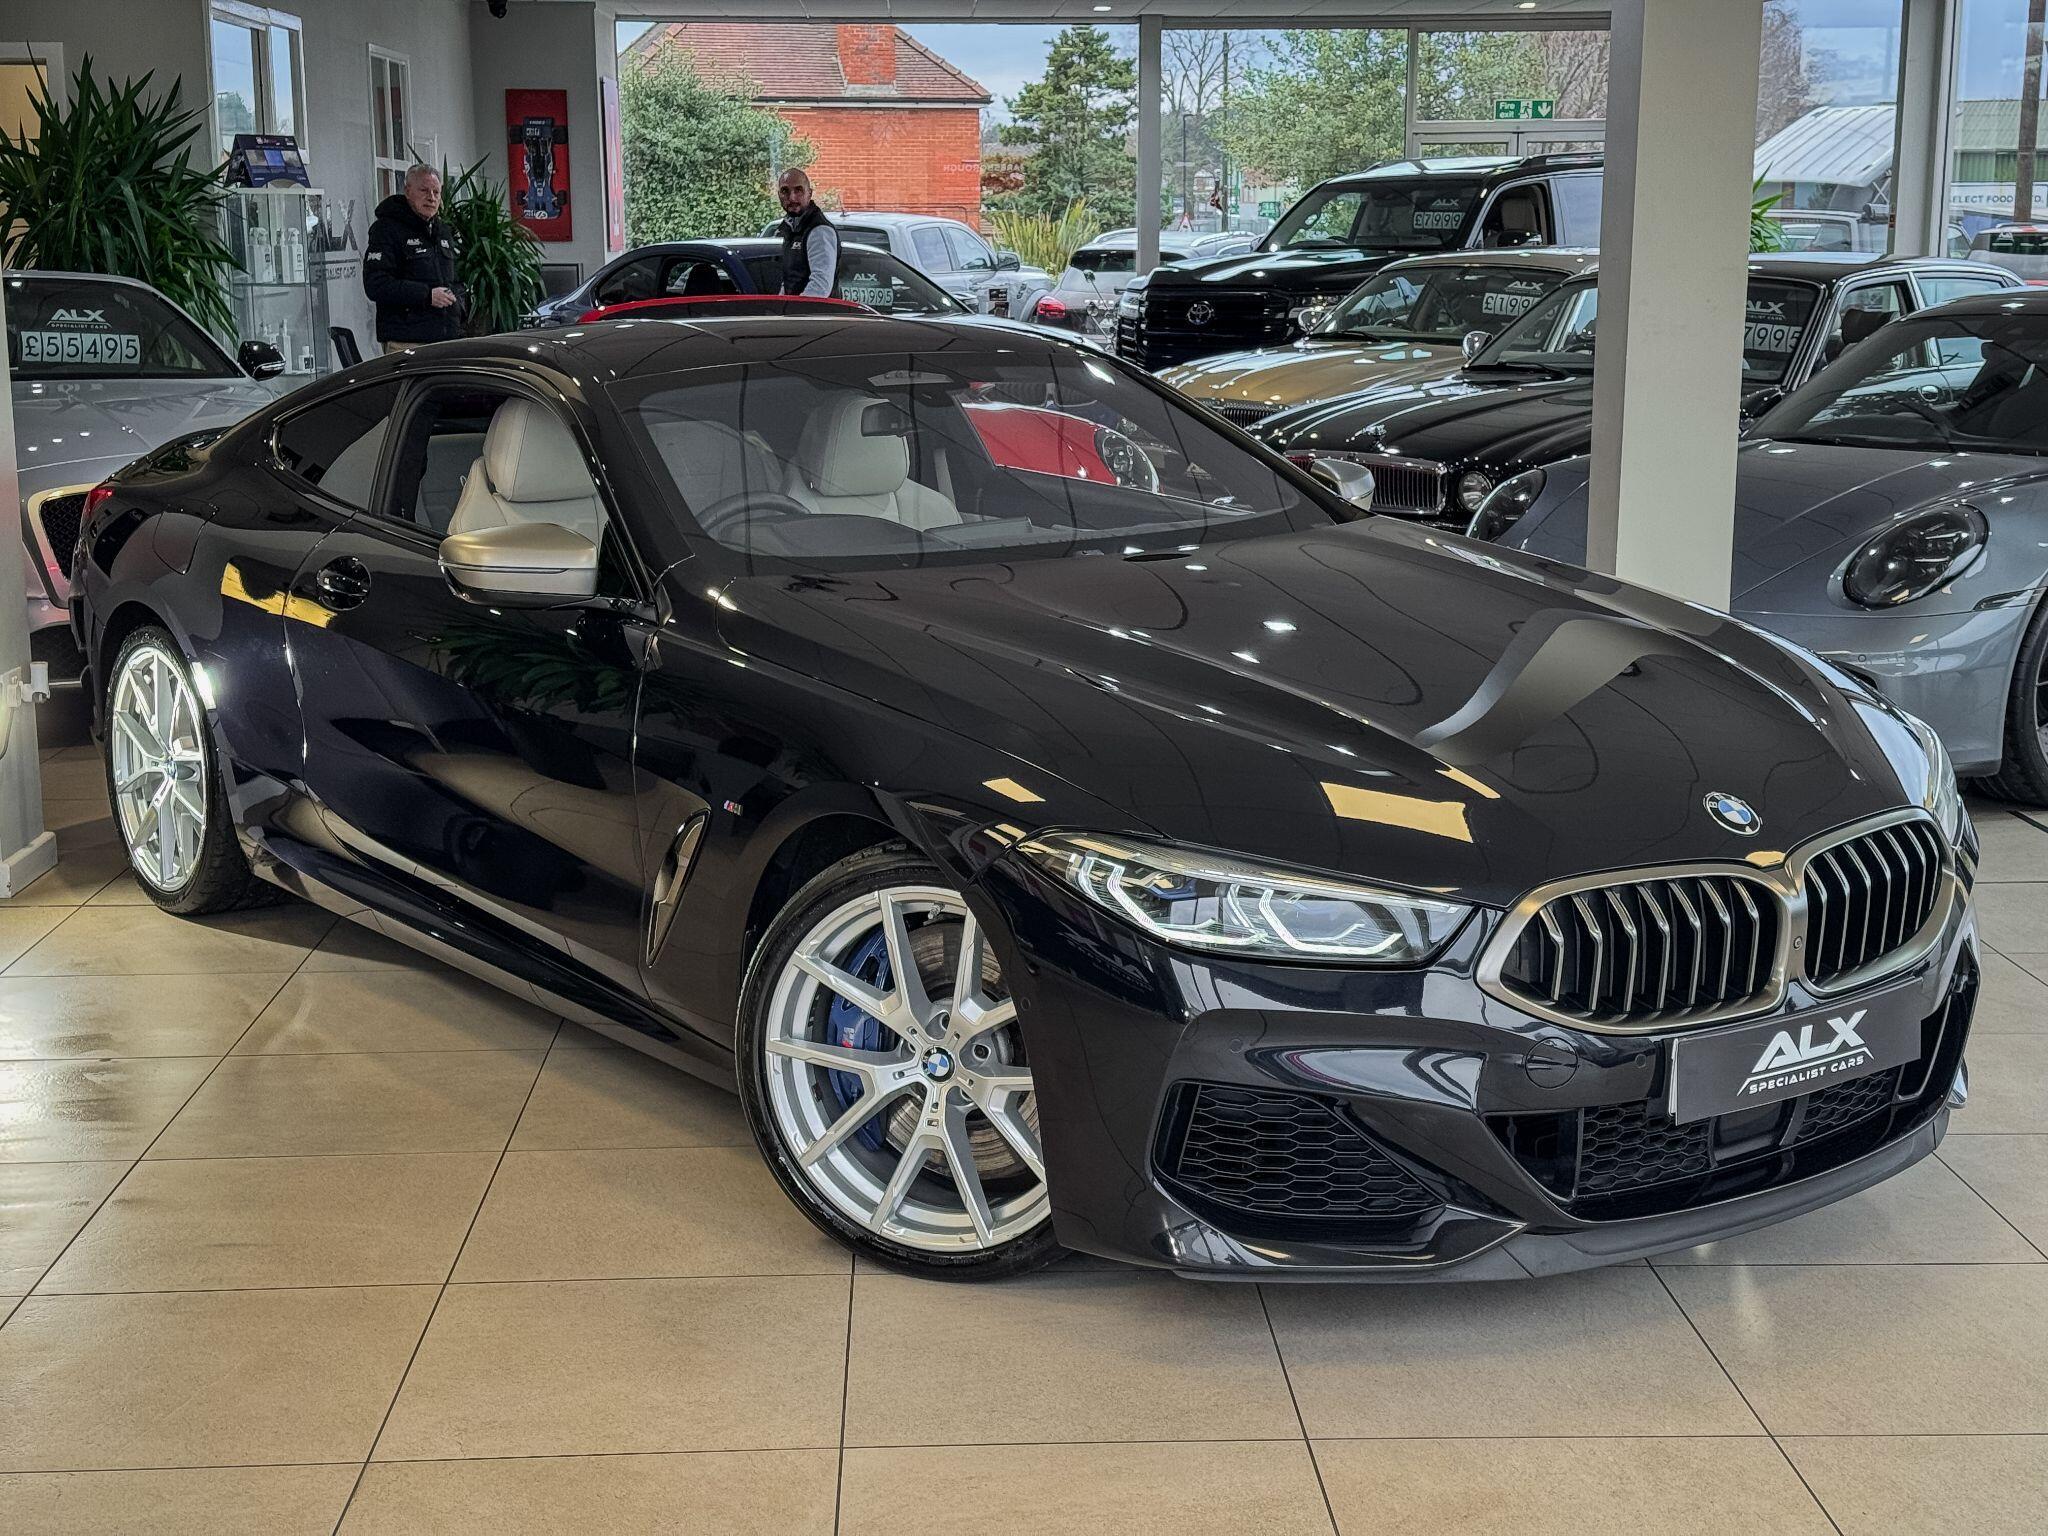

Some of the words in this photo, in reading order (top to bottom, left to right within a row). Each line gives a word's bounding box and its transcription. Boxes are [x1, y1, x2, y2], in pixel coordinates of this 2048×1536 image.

[854, 273, 878, 281] ALX
[1508, 280, 1544, 291] ALX
[51, 308, 106, 322] ALX
[25, 335, 139, 360] £55495
[1752, 1009, 1868, 1073] ALX
[1749, 1066, 1827, 1095] SPECIALIST
[1830, 1055, 1865, 1073] CARS
